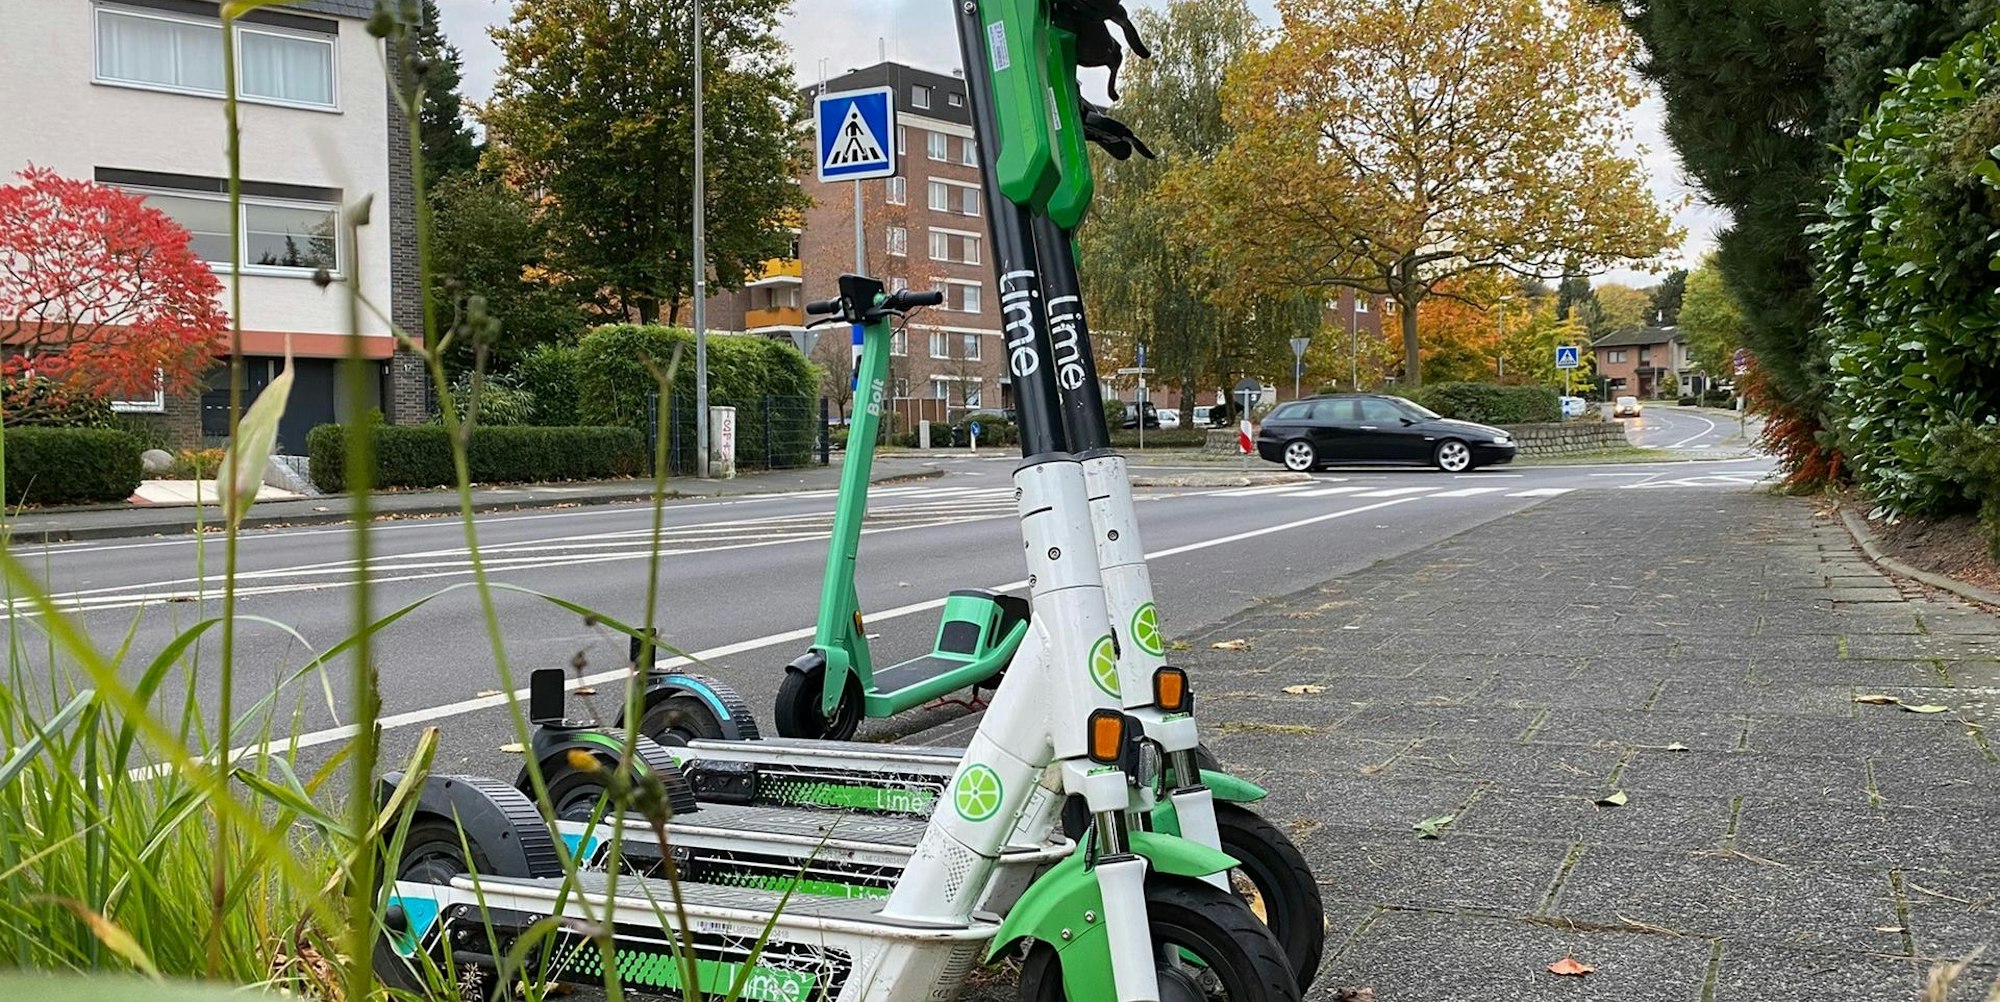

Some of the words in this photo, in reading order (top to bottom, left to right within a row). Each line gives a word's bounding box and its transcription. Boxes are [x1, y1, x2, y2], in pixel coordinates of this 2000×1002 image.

[1000, 270, 1039, 377] Lime
[1047, 295, 1085, 390] Lime
[867, 379, 884, 416] Bolt
[877, 789, 923, 812] Lime
